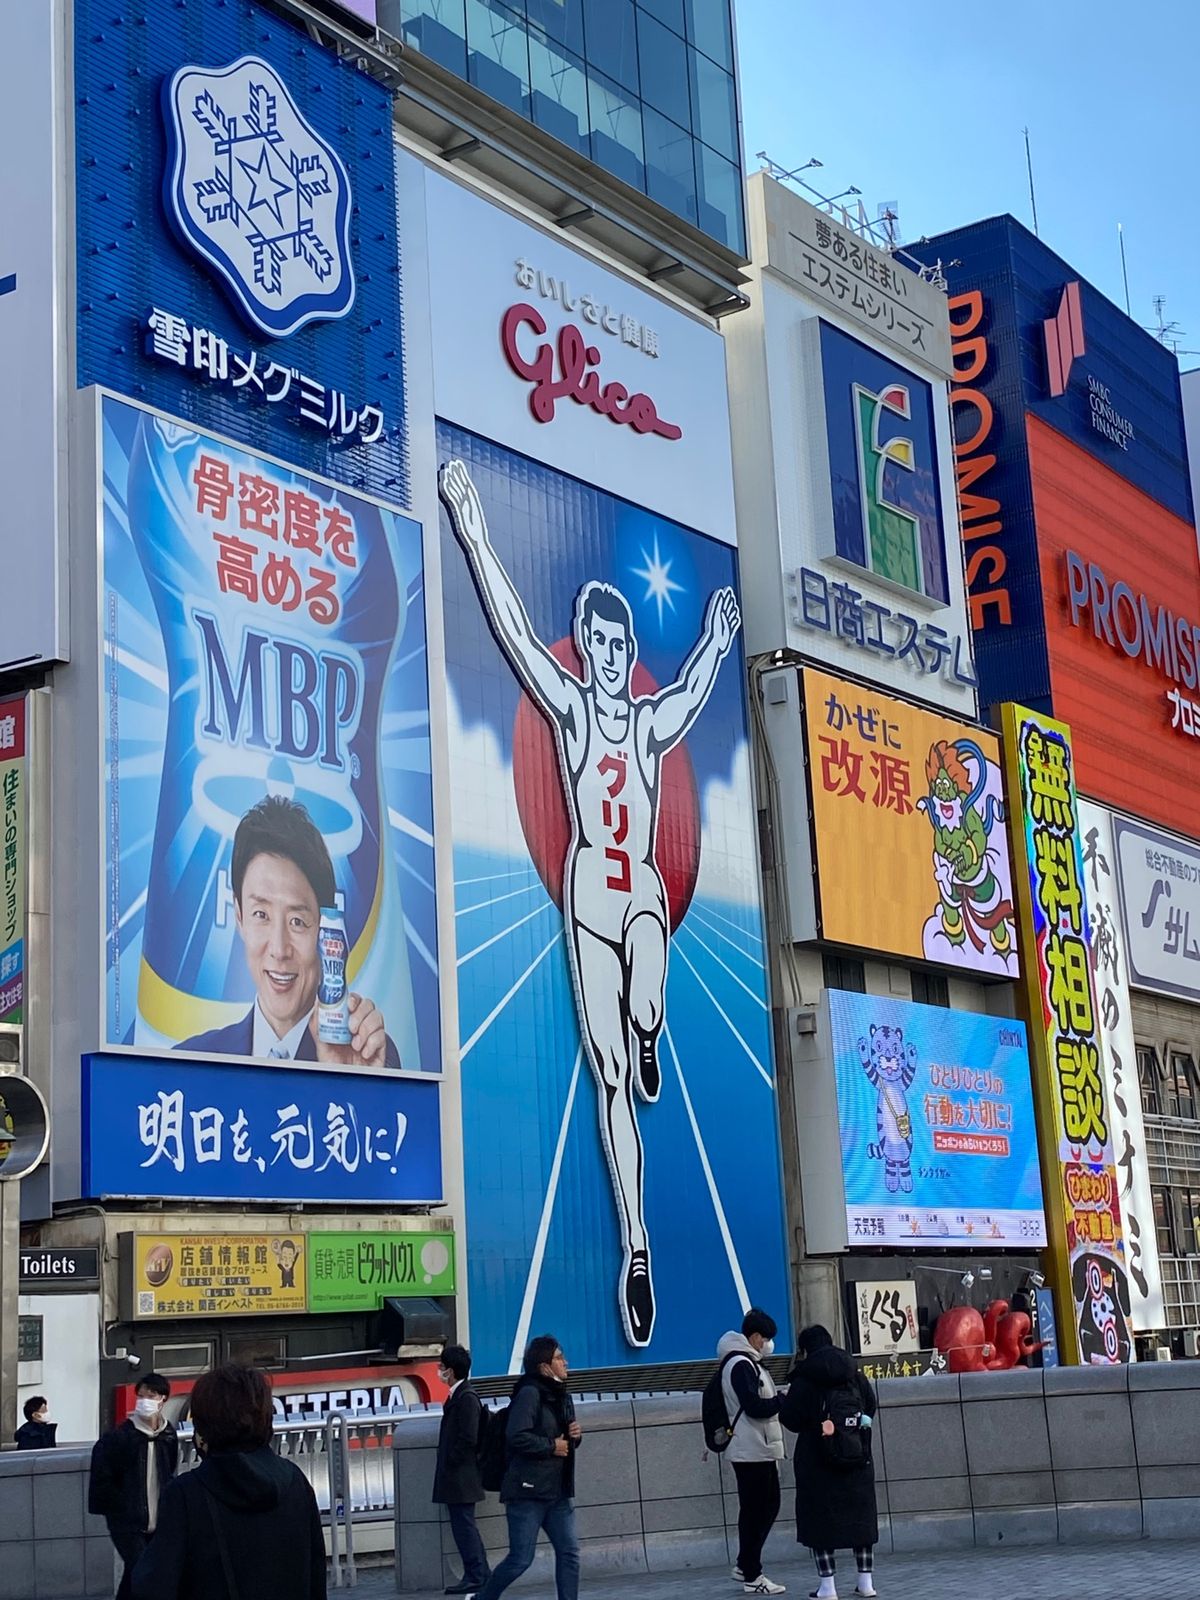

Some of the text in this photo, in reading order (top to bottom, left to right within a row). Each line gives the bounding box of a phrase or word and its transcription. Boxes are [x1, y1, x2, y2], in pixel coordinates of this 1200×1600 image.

[815, 218, 907, 296] 夢ある住まい
[515, 258, 660, 359] おいしさと健康
[802, 253, 925, 351] エステムシリーズ
[146, 307, 384, 442] 雪印メグミルク
[502, 303, 682, 440] Glico
[1088, 374, 1111, 405] SMBC
[1090, 394, 1135, 440] CONSUMER
[1092, 411, 1128, 451] FINANCE
[193, 454, 357, 568] 骨密度を
[213, 532, 340, 625] 高める
[192, 613, 359, 767] MBP
[825, 693, 901, 750] かぜに
[818, 734, 914, 816] 改源
[3, 769, 19, 942] 住まいの専門ショップ
[596, 750, 632, 893] グリコ
[1026, 727, 1107, 1146] 無料相談
[929, 1064, 1003, 1095] ひとりひとりの
[1069, 1172, 1111, 1203] ひまわり
[21, 1254, 76, 1274] Toilets
[181, 1246, 268, 1266] 店舗情報館
[358, 1242, 416, 1284] ピタットハウス
